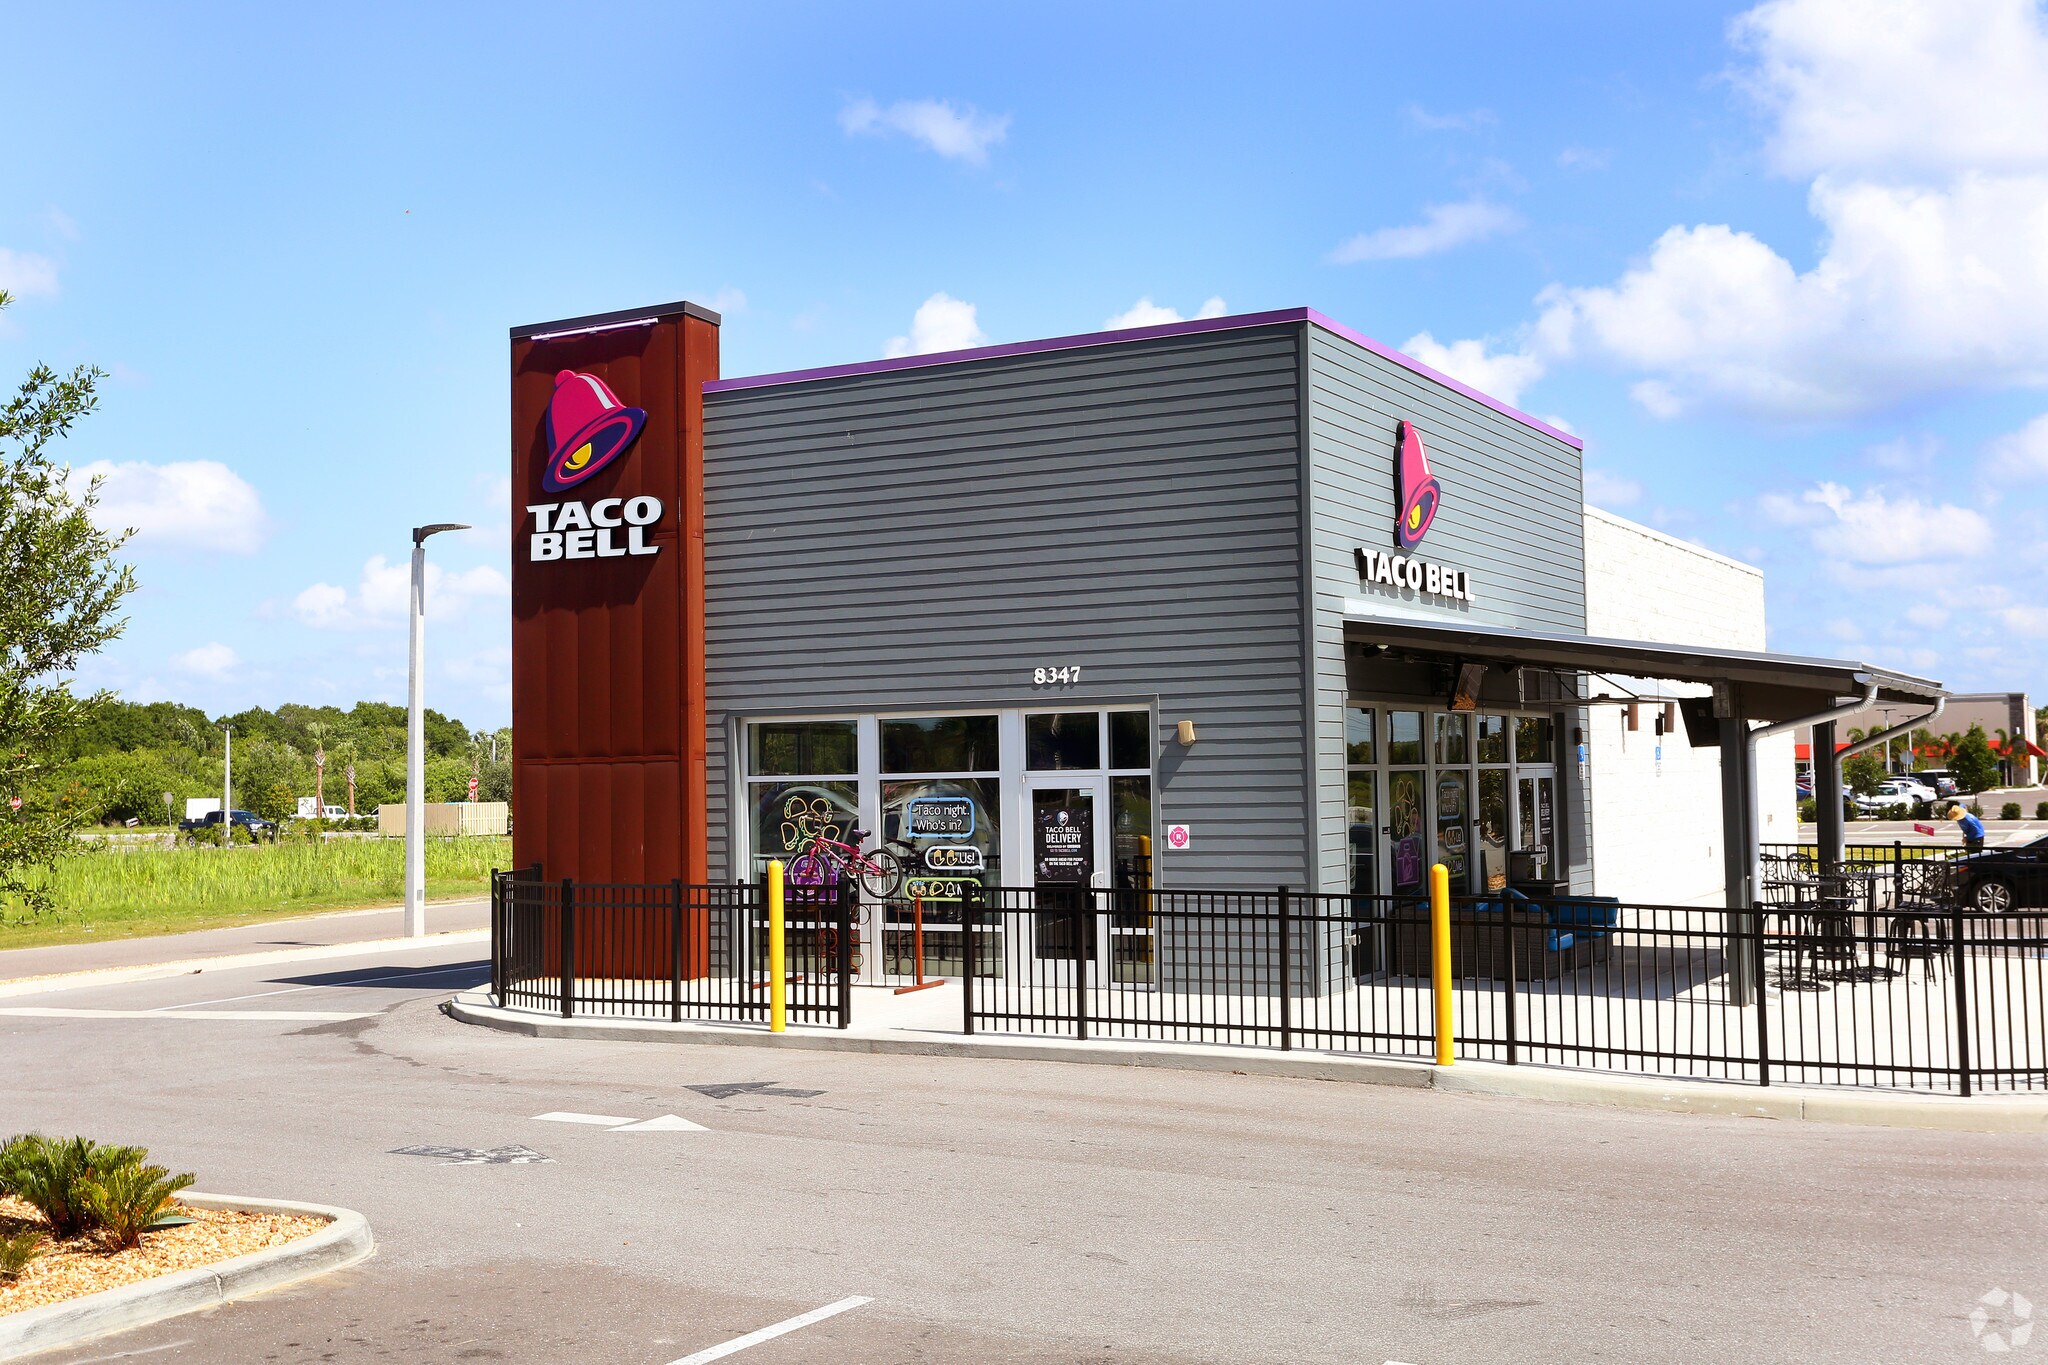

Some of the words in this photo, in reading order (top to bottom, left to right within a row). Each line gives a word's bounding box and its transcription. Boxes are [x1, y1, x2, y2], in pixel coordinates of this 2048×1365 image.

[525, 495, 663, 533] TACO
[530, 526, 660, 562] BELL
[1360, 547, 1423, 590] TACO
[1425, 562, 1476, 602] BELL
[1033, 666, 1081, 685] 8347
[916, 804, 941, 816] Taco
[943, 804, 970, 818] night.
[916, 819, 946, 831] Who's
[949, 819, 963, 831] in?
[1045, 833, 1082, 843] DELIVERY
[959, 852, 975, 864] Us!
